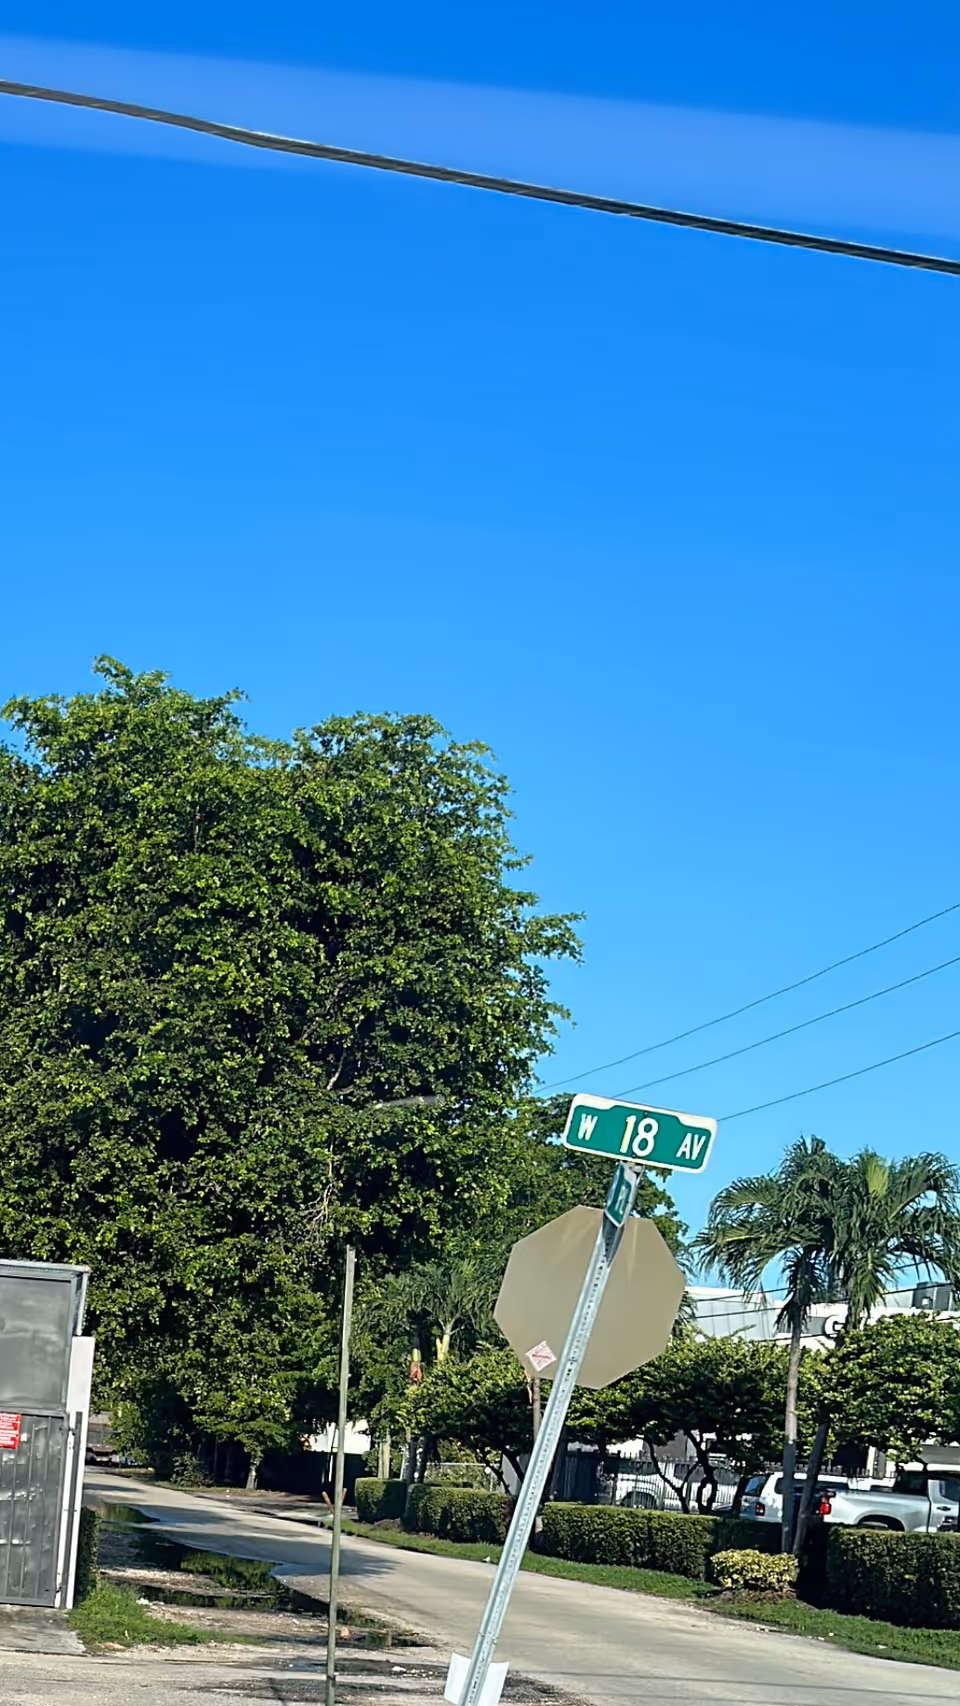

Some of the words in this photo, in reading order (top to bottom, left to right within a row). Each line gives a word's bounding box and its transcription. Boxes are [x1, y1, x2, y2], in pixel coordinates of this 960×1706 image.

[577, 1112, 599, 1141] W
[619, 1115, 659, 1157] 18
[675, 1132, 706, 1161] AV
